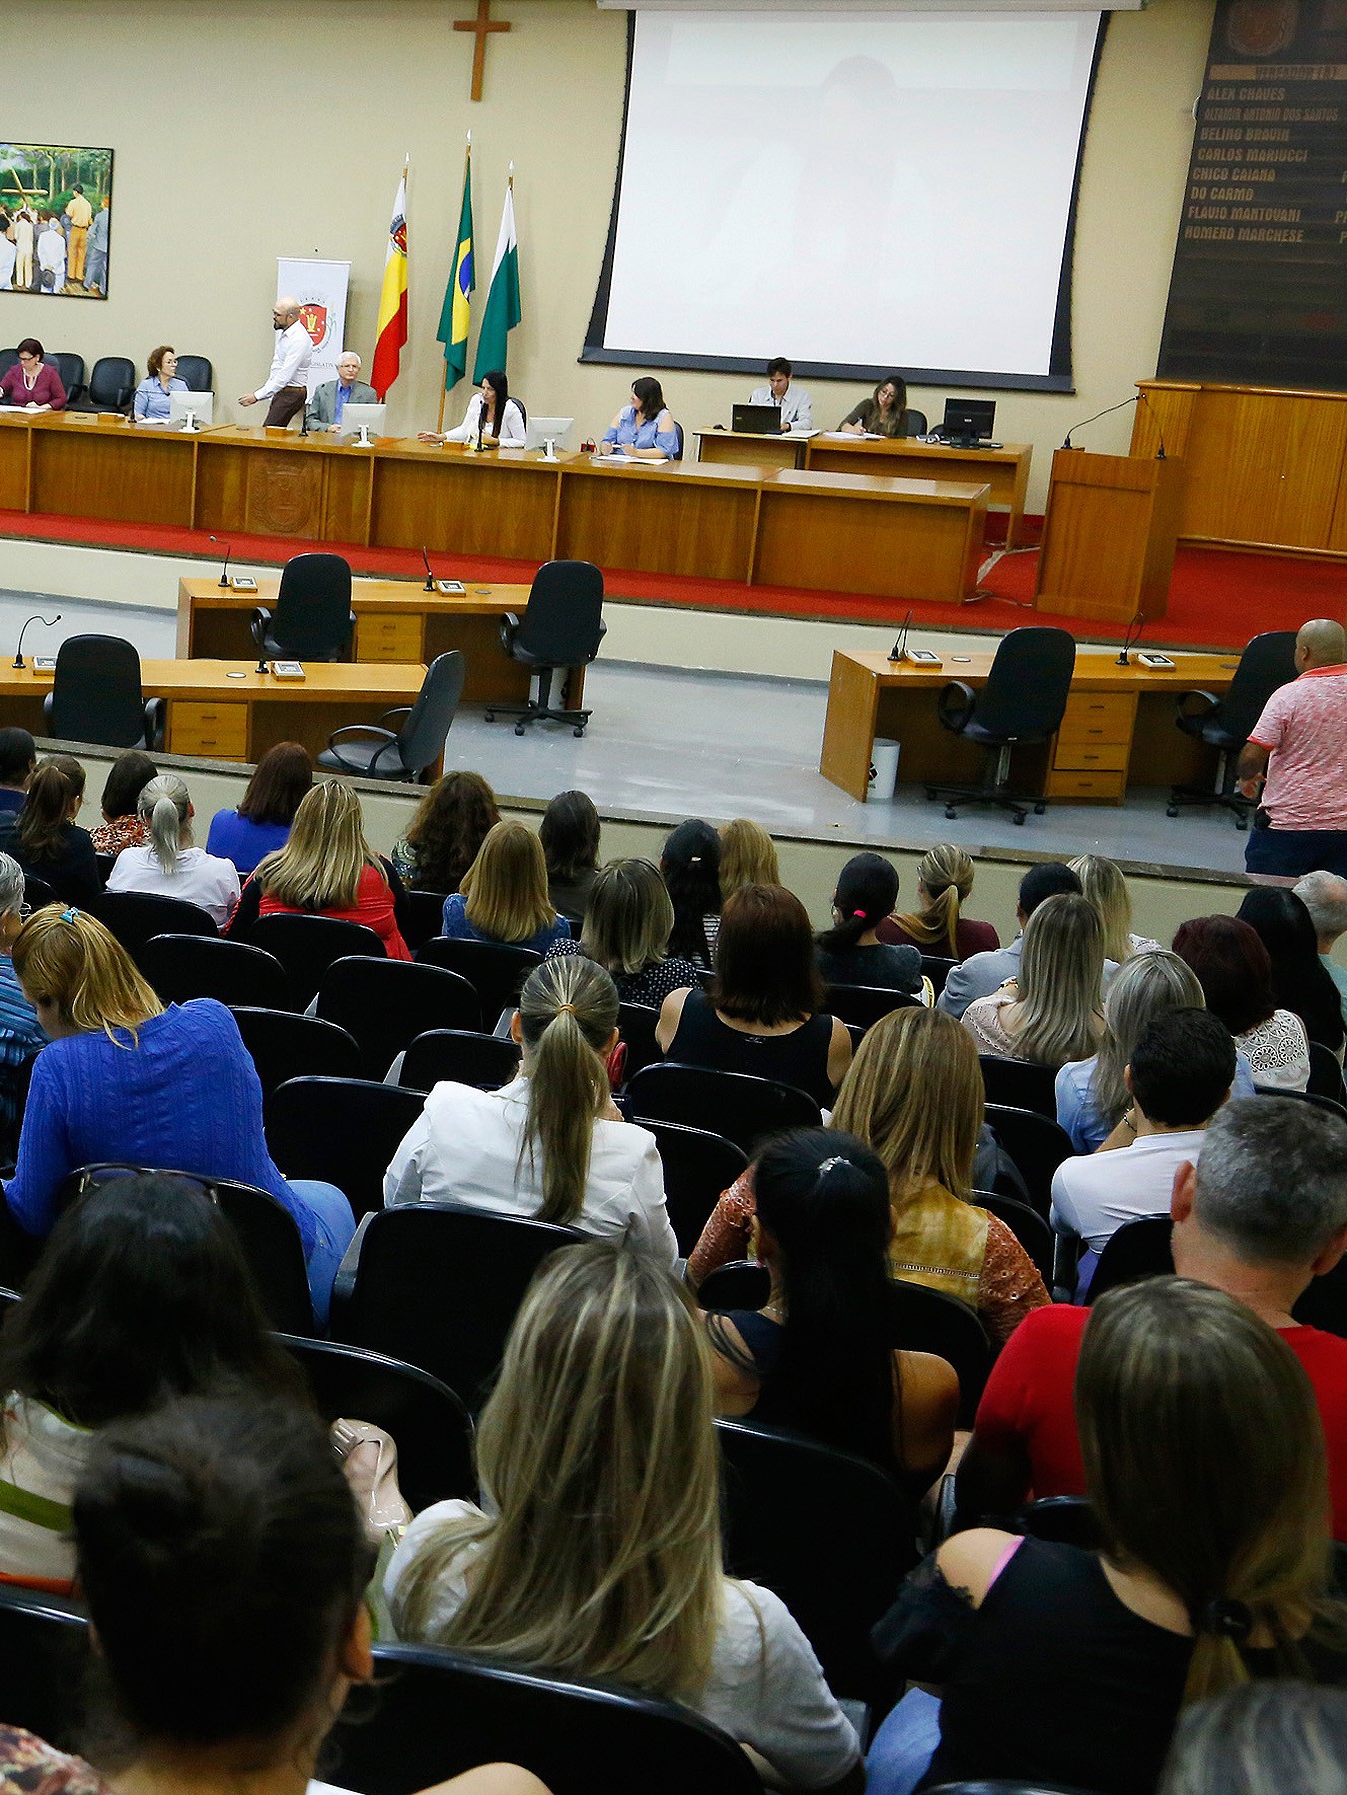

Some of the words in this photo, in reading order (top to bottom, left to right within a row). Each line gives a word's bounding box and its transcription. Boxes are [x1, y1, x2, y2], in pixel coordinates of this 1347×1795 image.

[1197, 147, 1243, 161] CARLOS
[1192, 166, 1229, 181] CHICO
[1190, 186, 1207, 200] DO
[1210, 187, 1255, 201] CARMO
